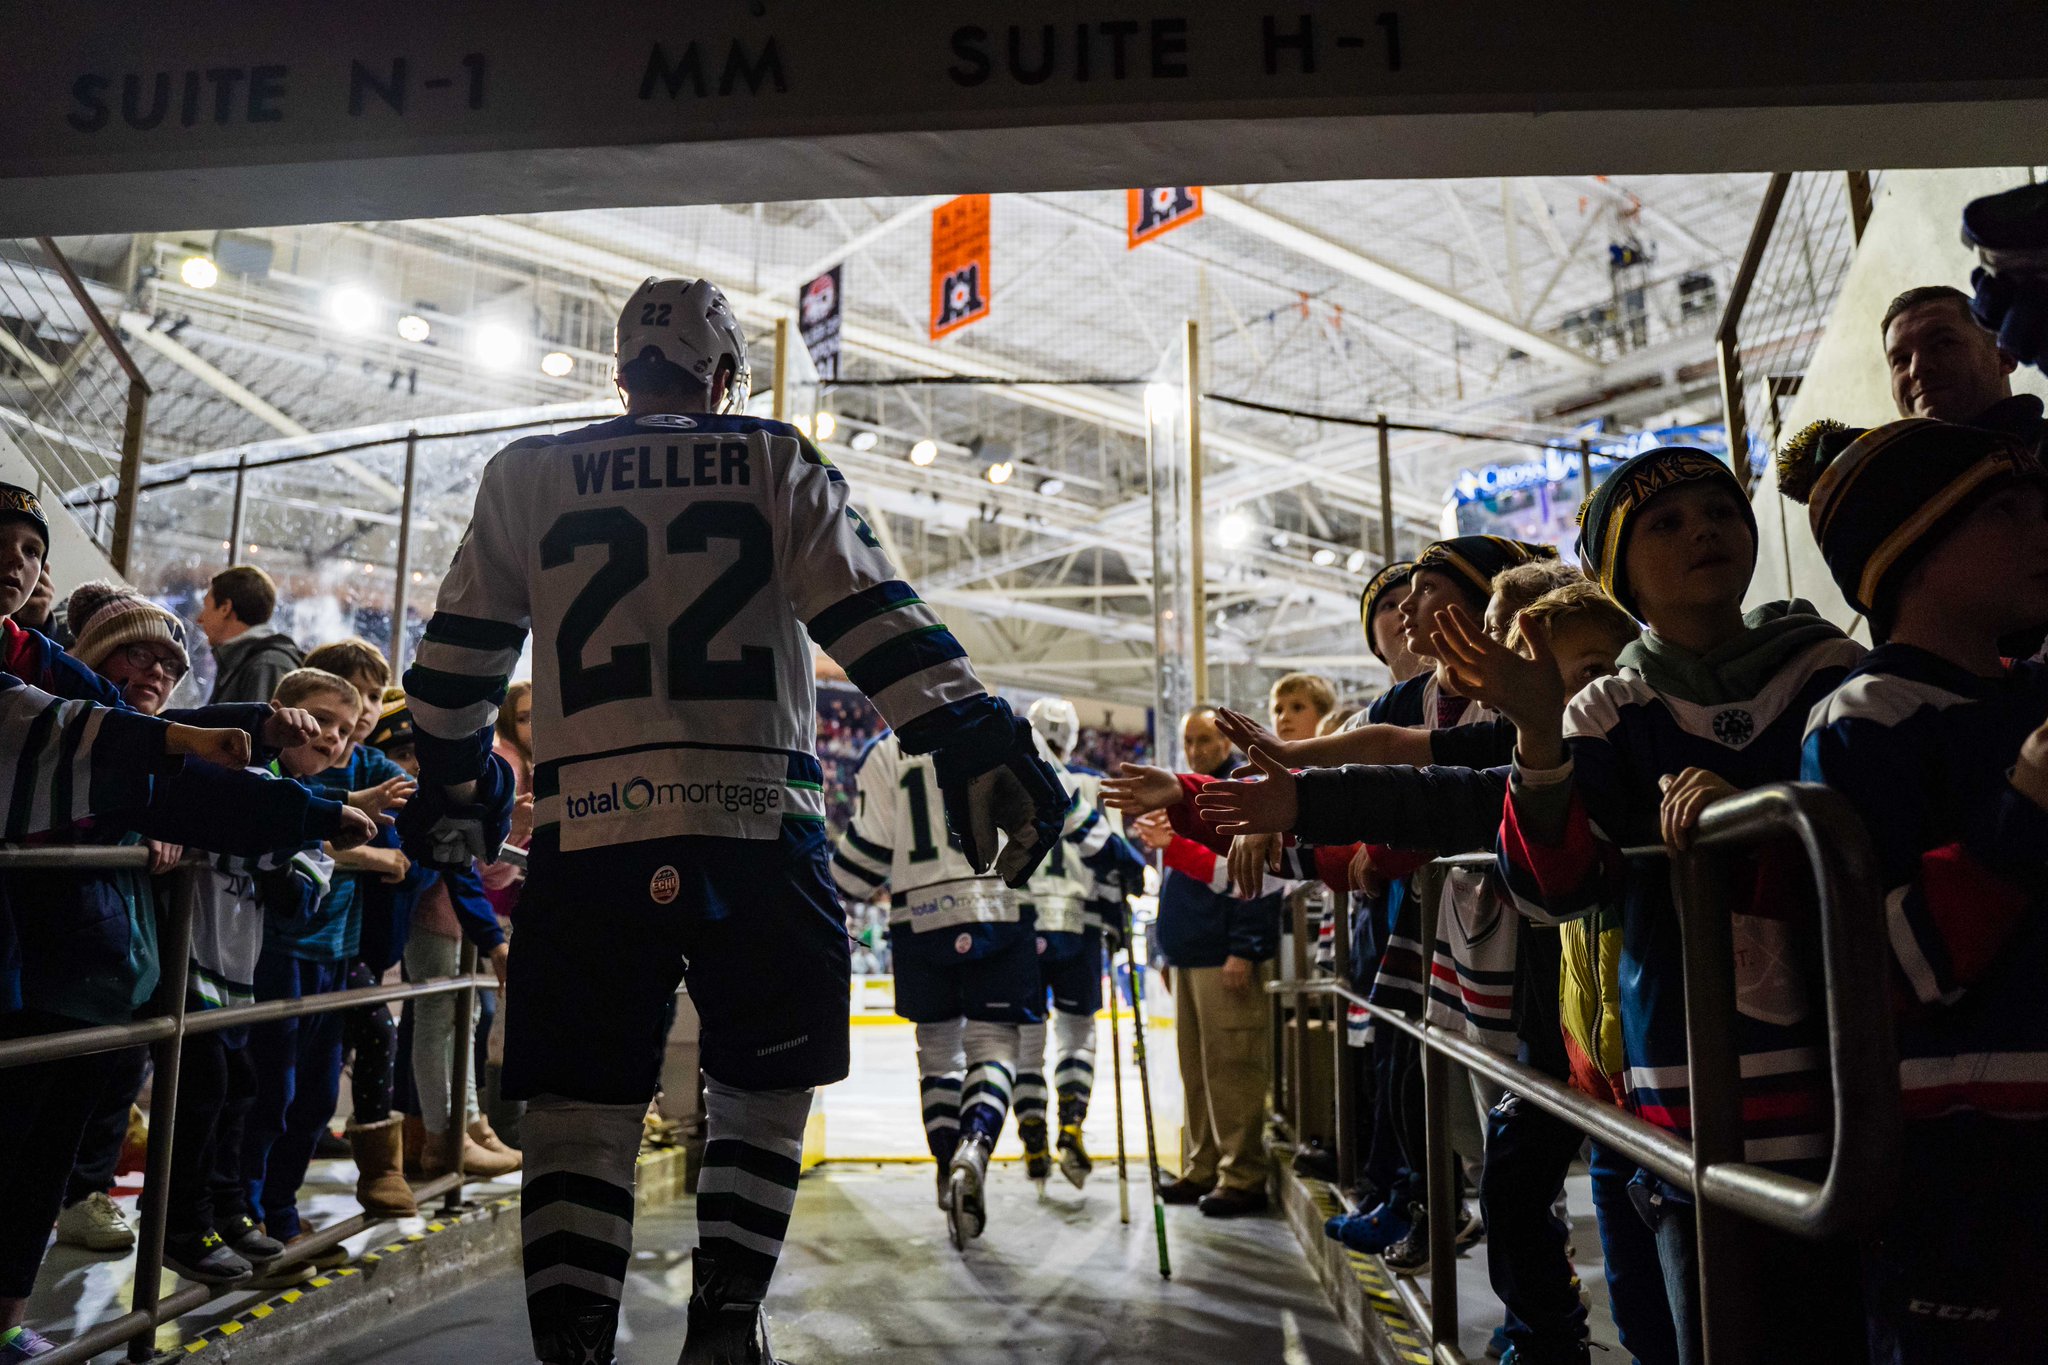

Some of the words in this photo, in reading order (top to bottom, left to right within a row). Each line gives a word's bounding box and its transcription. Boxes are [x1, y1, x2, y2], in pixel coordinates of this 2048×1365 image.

[638, 37, 787, 100] MM
[948, 18, 1188, 87] SUITE
[1262, 12, 1401, 74] H-1
[66, 65, 287, 133] SUITE
[347, 53, 486, 117] N-1
[641, 303, 672, 326] 22
[572, 442, 750, 495] WELLER
[540, 501, 777, 717] 22
[566, 782, 620, 819] total
[657, 780, 779, 814] mortgage
[1908, 1299, 2000, 1321] CCM
